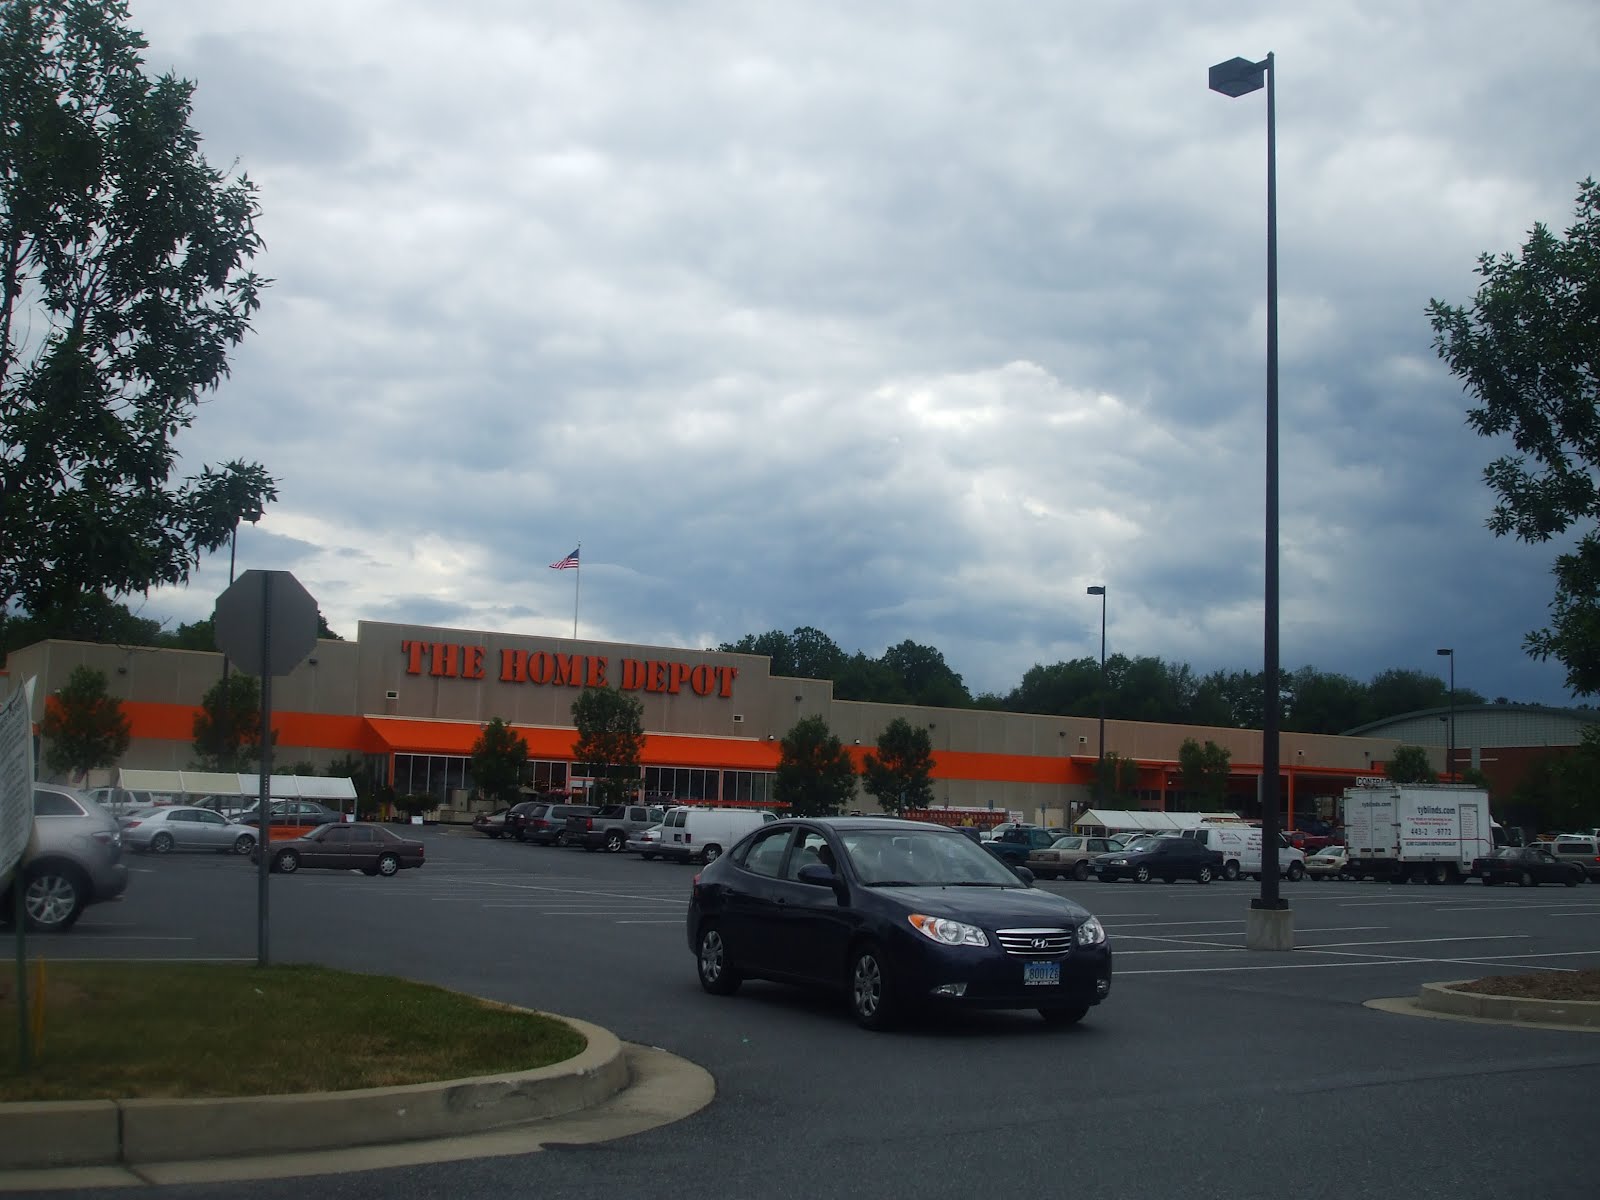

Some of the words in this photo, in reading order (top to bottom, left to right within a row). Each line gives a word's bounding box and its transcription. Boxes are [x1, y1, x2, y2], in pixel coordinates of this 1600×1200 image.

[402, 640, 486, 680] THE
[499, 648, 609, 688] HOME
[621, 658, 738, 697] DEPOT
[1417, 806, 1455, 815] tyblinds.com
